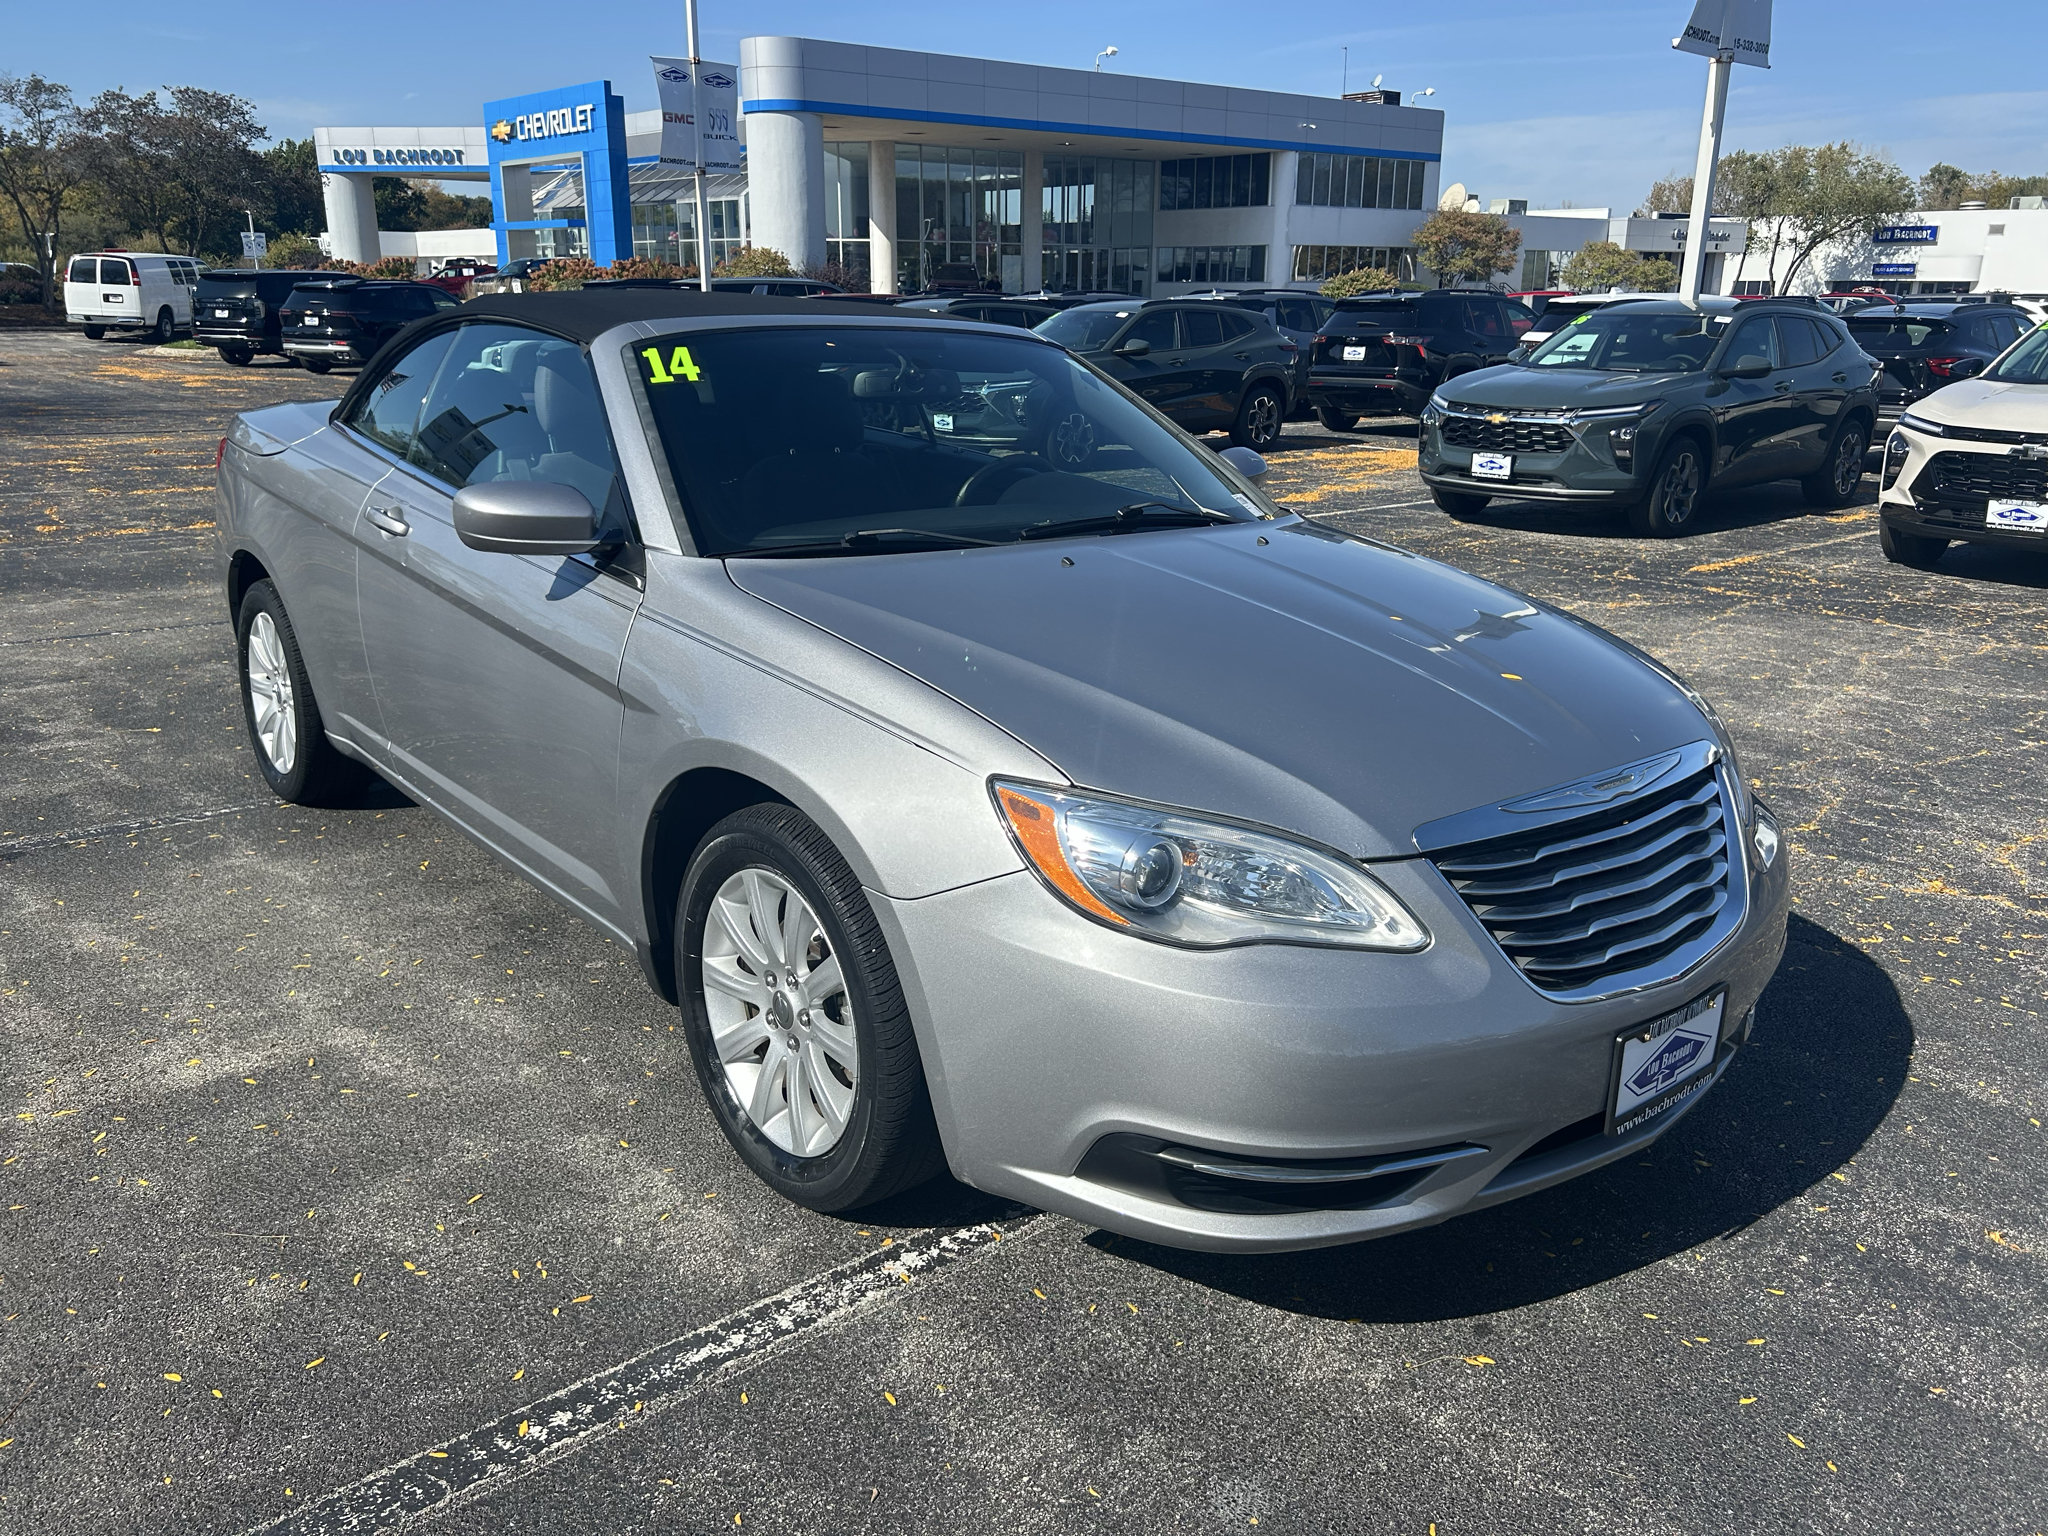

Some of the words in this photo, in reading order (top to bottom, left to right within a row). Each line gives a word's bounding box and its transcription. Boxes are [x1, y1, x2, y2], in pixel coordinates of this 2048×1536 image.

[516, 103, 593, 141] CHEVROLET
[663, 112, 695, 125] GMC
[703, 133, 738, 141] BUICK
[333, 149, 367, 165] LOU
[372, 149, 465, 165] BACHRODT
[641, 346, 701, 383] 14
[1647, 1060, 1660, 1076] LOU
[1616, 1073, 1713, 1135] www.bachrodt.com
